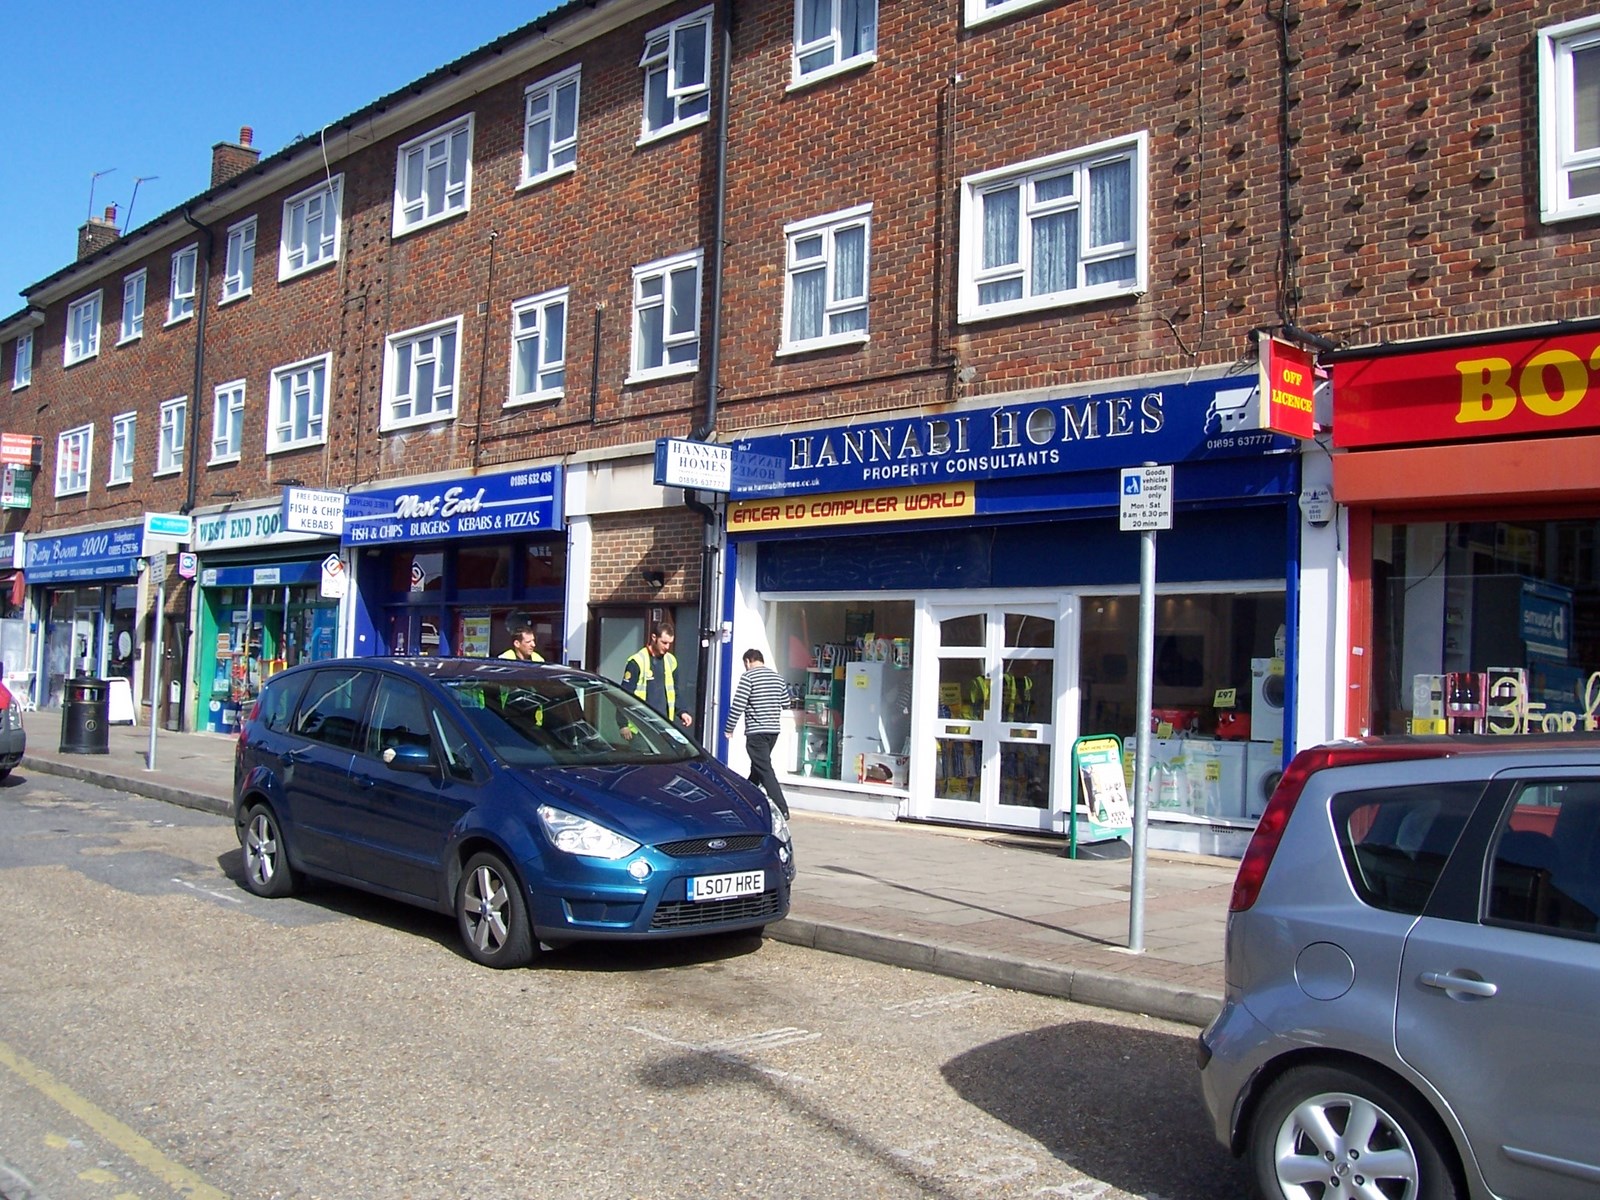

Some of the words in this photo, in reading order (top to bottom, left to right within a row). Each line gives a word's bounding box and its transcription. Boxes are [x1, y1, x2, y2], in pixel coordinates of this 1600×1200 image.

[1283, 370, 1302, 386] OFF
[1272, 390, 1312, 412] LICENCE
[789, 417, 970, 470] HANNABI
[991, 392, 1164, 450] HOMES
[1207, 438, 1234, 449] 01895
[1238, 434, 1273, 446] 637777
[680, 457, 726, 472] HOMES
[863, 460, 939, 481] PROPERTY
[946, 449, 1059, 474] CONSULTANTS
[528, 473, 539, 486] 632
[540, 472, 552, 484] 436
[296, 492, 311, 500] FREE
[313, 494, 340, 503] DELIVERY
[441, 486, 486, 518] End
[904, 490, 965, 512] WORLD
[290, 503, 309, 514] FISH
[312, 506, 318, 515] &
[200, 520, 226, 542] WEST
[230, 518, 251, 539] END
[300, 519, 334, 530] KEBABS
[410, 520, 450, 536] BURGERS
[458, 516, 492, 532] KEBABS
[494, 516, 502, 528] &
[504, 510, 540, 528] PIZZAS
[352, 527, 368, 541] FISH
[370, 526, 378, 538] &
[379, 524, 403, 538] CHIPS
[32, 543, 50, 566] Baby
[53, 540, 78, 560] Boom
[80, 535, 108, 556] 2000
[1490, 676, 1521, 735] 3
[696, 878, 732, 896] LS07
[736, 874, 761, 892] HRE
